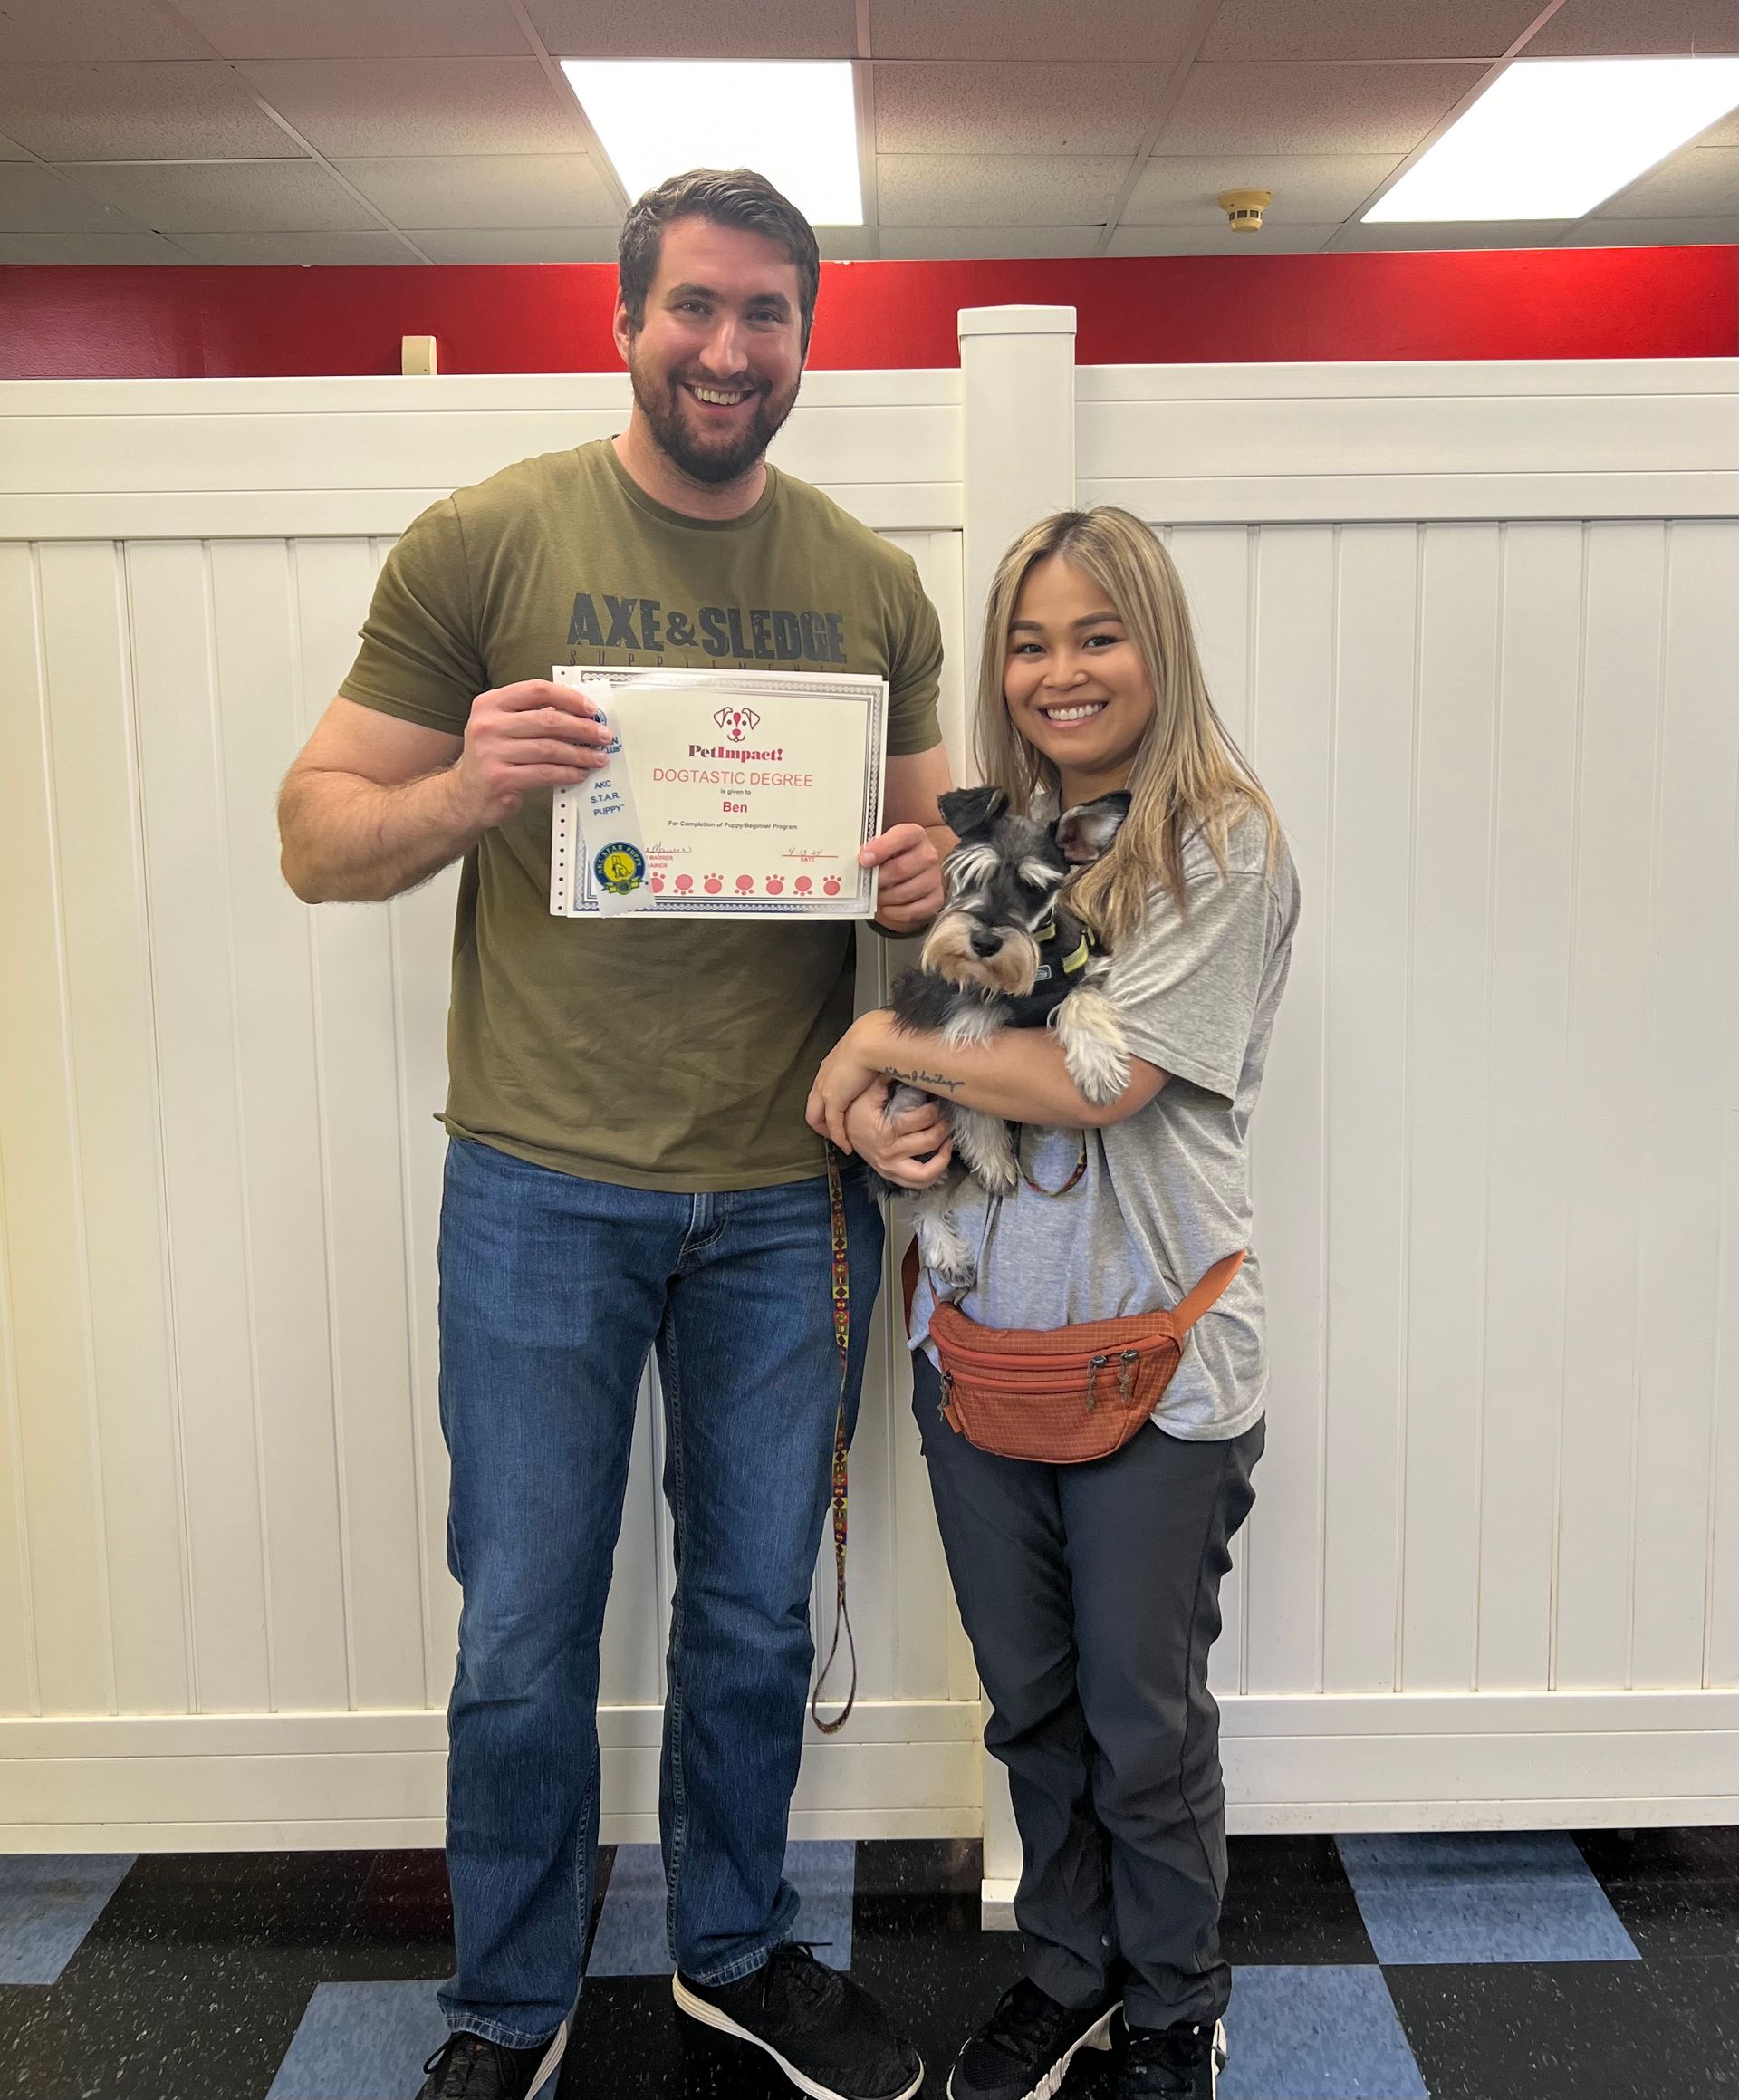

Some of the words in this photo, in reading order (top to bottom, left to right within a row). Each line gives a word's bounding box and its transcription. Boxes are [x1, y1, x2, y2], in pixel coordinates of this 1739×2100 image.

[688, 744, 783, 763] PetImpact!
[653, 768, 745, 785] DOGTASTIC
[750, 772, 813, 787] DEGREE
[594, 780, 611, 789] AKC
[723, 801, 748, 813] Ben
[679, 820, 716, 828] Completion
